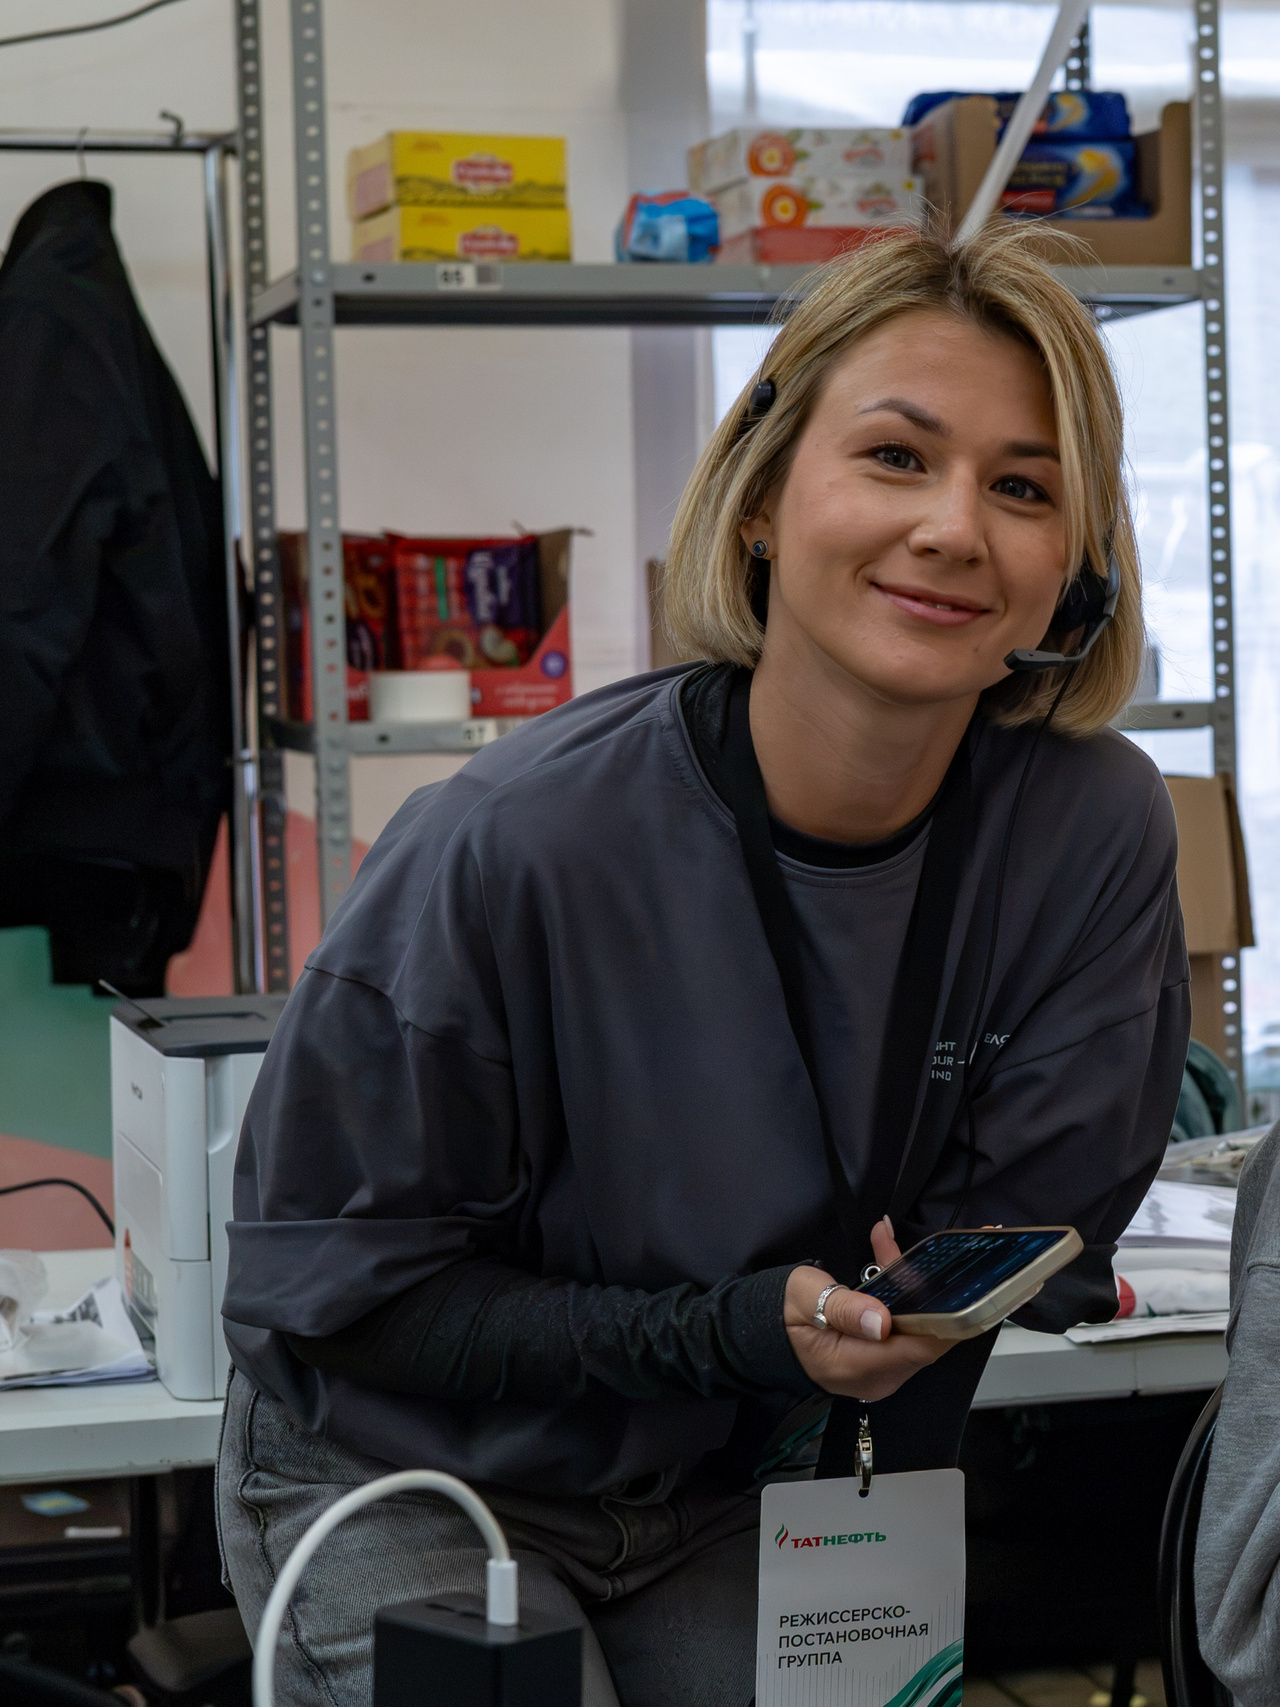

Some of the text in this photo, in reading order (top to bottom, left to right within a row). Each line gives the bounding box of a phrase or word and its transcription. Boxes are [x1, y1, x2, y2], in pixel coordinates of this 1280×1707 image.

[791, 1532, 887, 1549] ТАТНЕФТЬ
[779, 1605, 911, 1628] РЕЖИССЕРСКО-
[778, 1623, 929, 1649] ПОСТАНОВОЧНАЯ
[778, 1652, 842, 1669] ГРУППА
